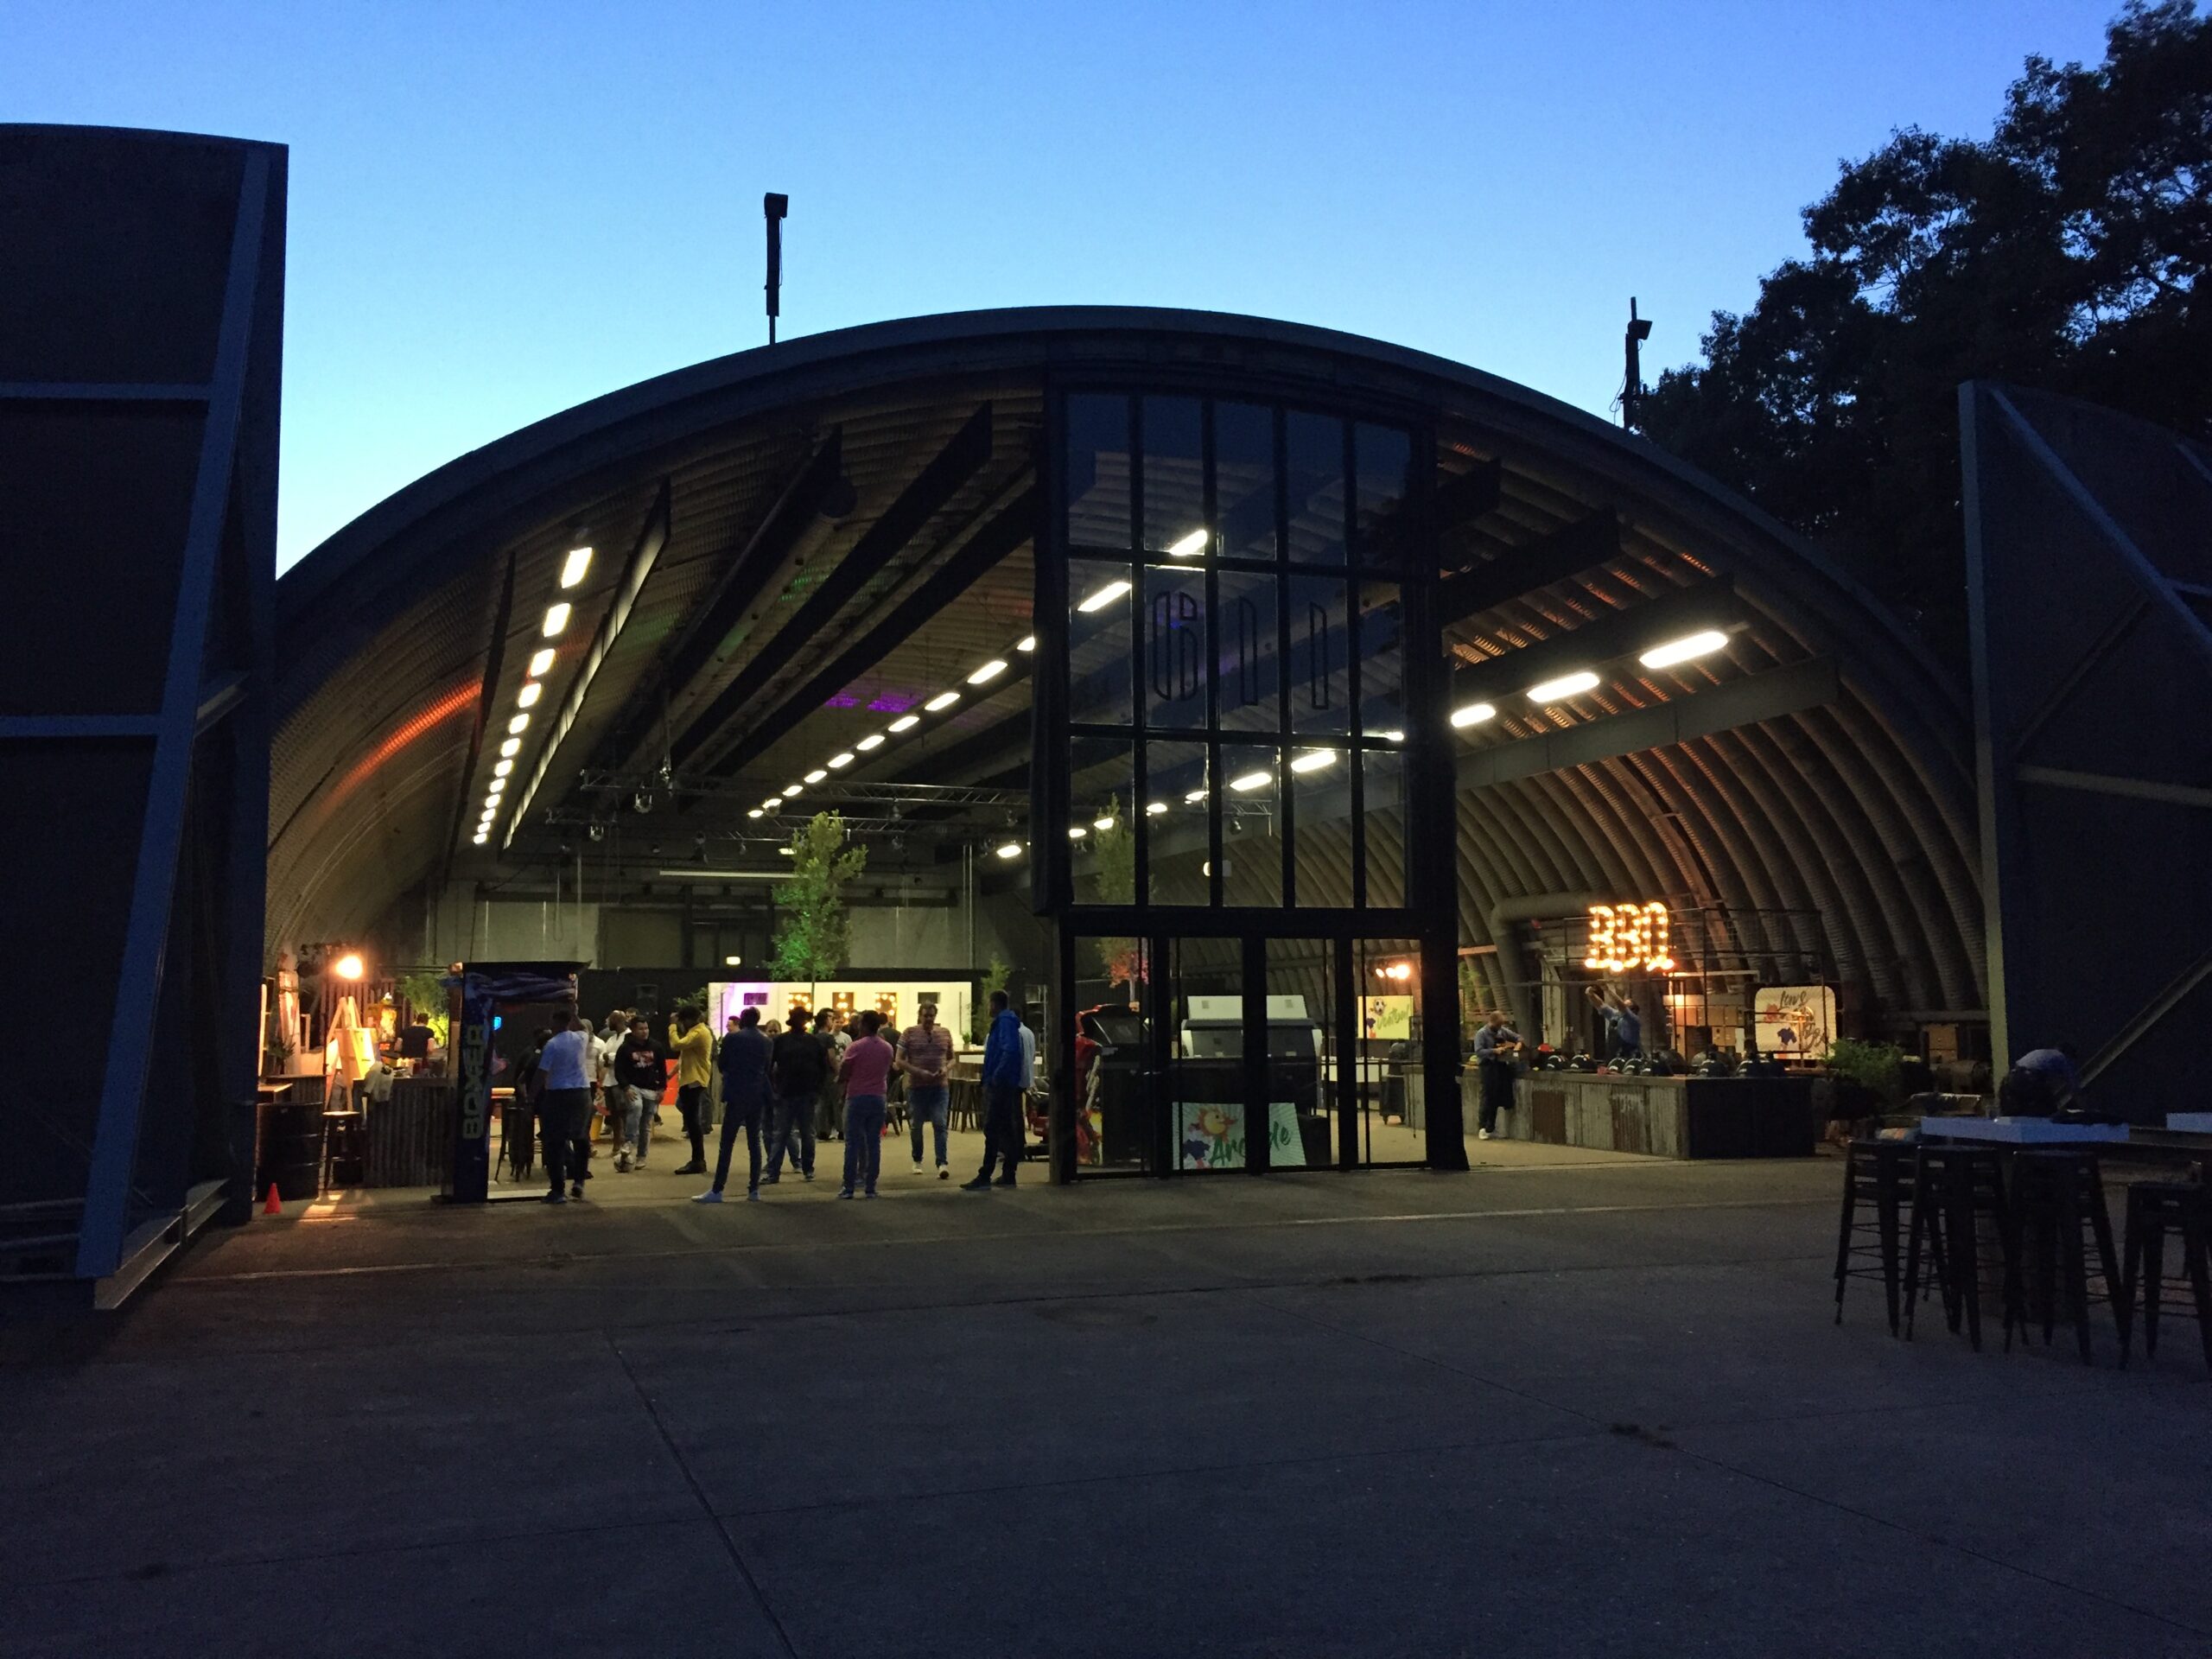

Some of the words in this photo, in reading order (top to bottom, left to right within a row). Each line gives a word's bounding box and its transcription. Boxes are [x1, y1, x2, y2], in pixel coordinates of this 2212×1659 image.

[1586, 902, 1674, 971] BBQ
[462, 1025, 484, 1139] BOXER
[1210, 1122, 1291, 1166] Arcde
